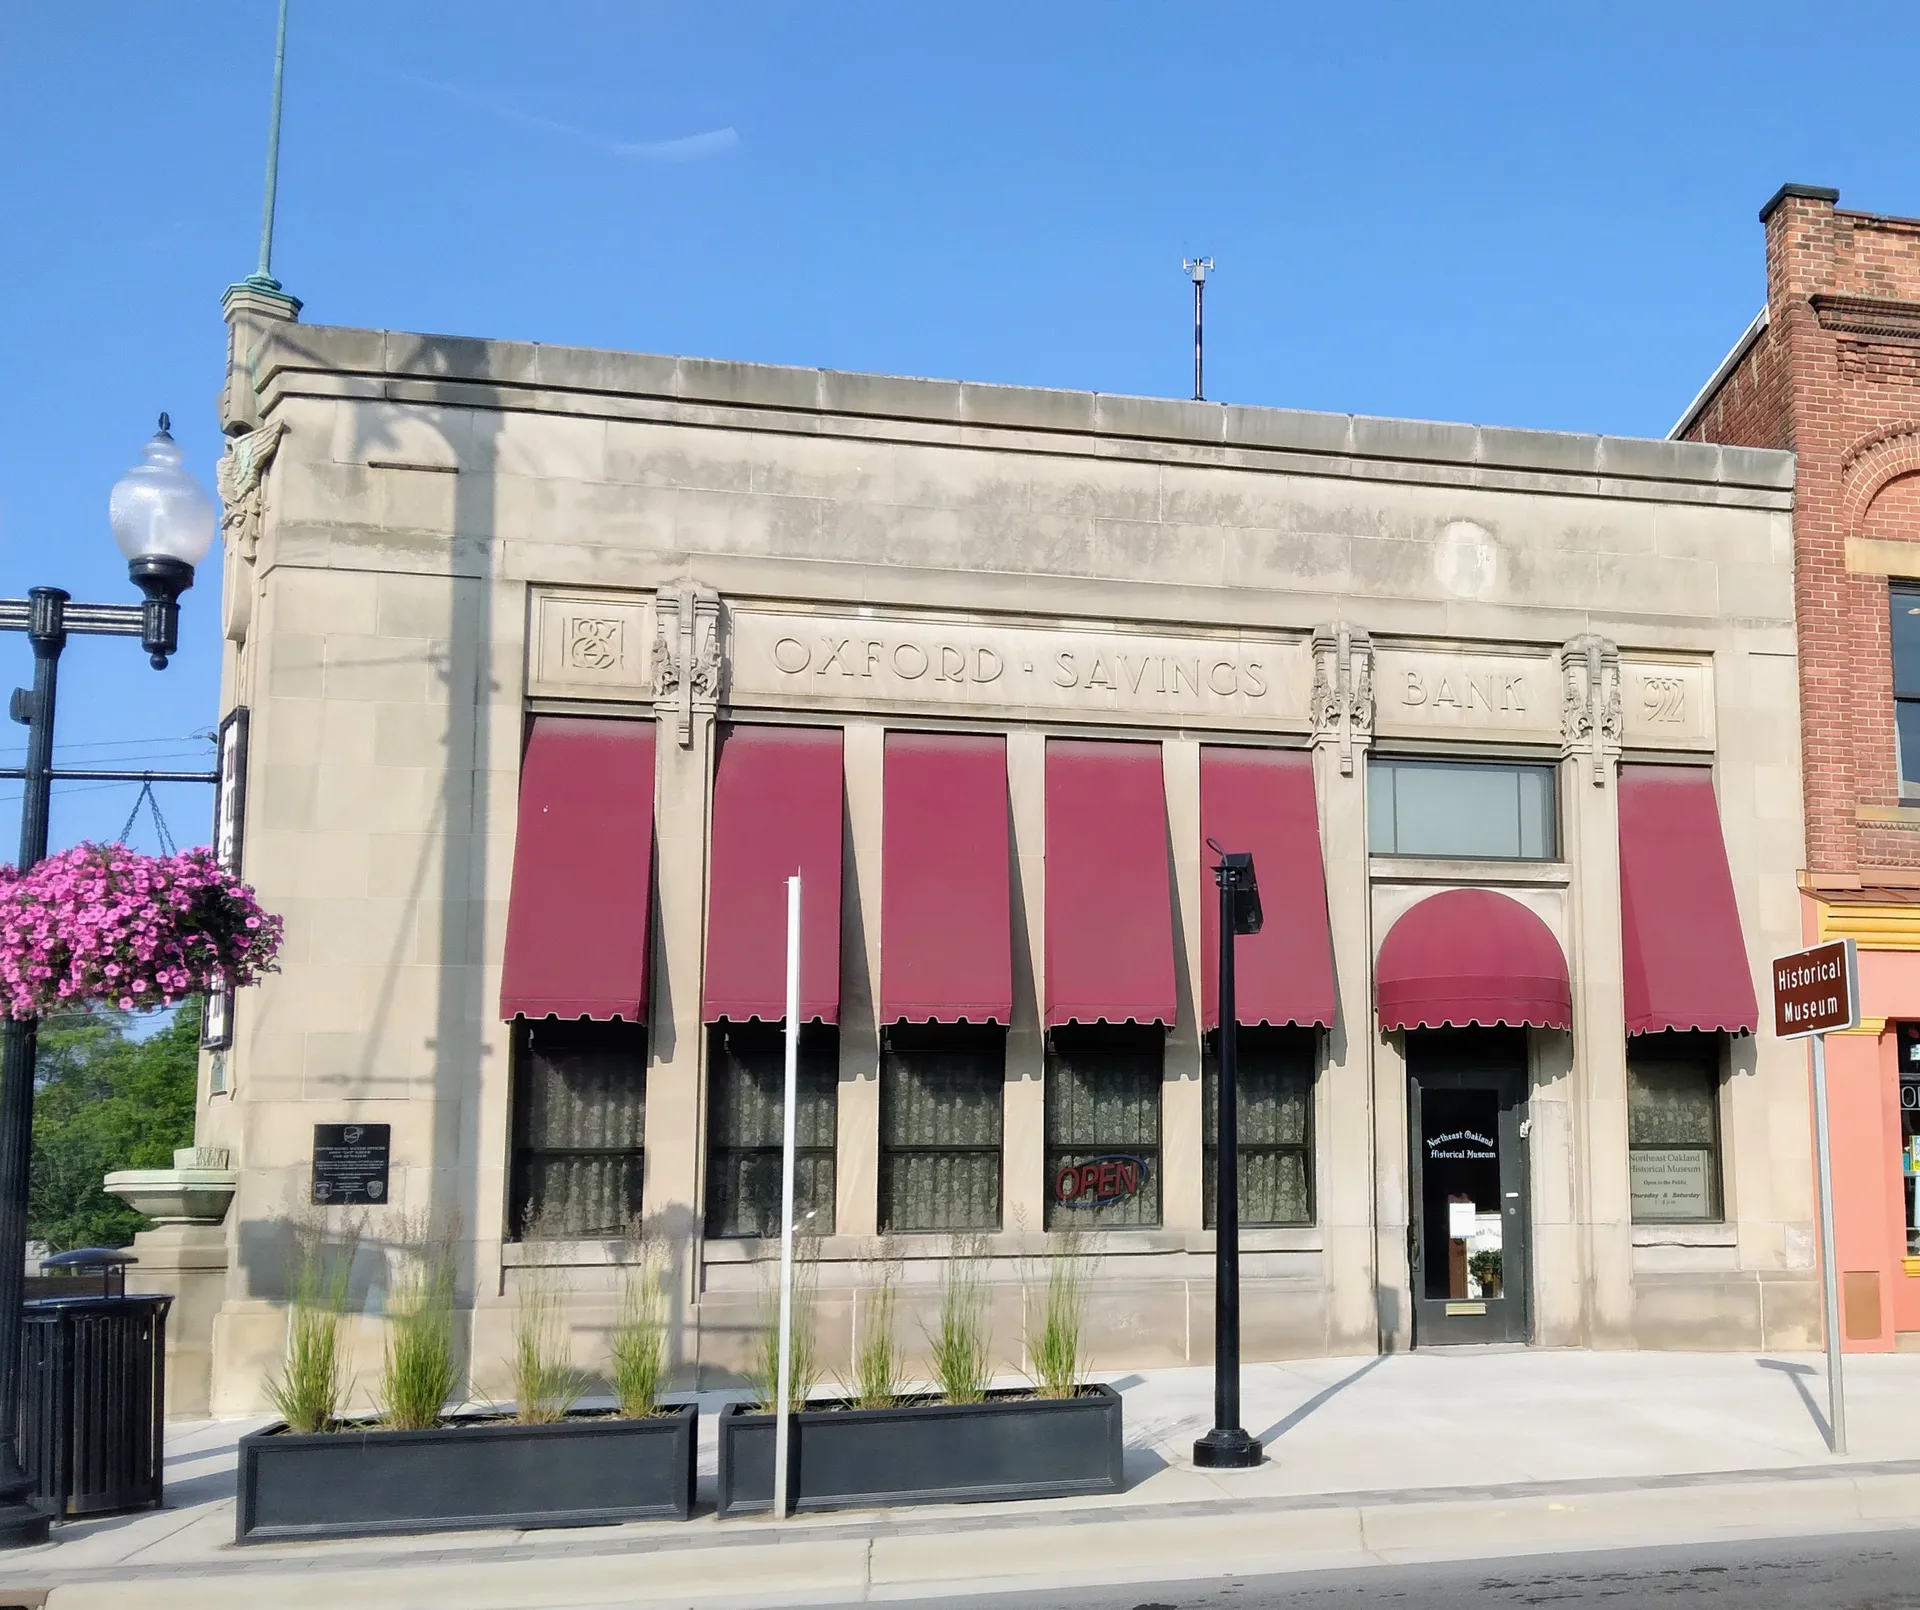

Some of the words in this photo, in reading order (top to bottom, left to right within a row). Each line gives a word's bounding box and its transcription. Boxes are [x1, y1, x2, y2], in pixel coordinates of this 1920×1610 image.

[773, 636, 1004, 684] OXFORD
[1053, 651, 1269, 697] SAVINGS
[1399, 671, 1527, 713] BANK
[1778, 956, 1841, 992] Historical
[1784, 996, 1838, 1023] Museum
[1901, 1085, 1920, 1108] O
[1426, 1130, 1463, 1149] Northeast
[1464, 1129, 1494, 1148] Oakland
[1430, 1149, 1465, 1159] Historical
[1466, 1149, 1496, 1159] Museum
[1629, 1153, 1666, 1162] Northeast
[1667, 1153, 1700, 1162] Oakland
[1055, 1161, 1138, 1200] OPEN
[1630, 1165, 1665, 1173] Historical
[1667, 1165, 1701, 1173] Museum
